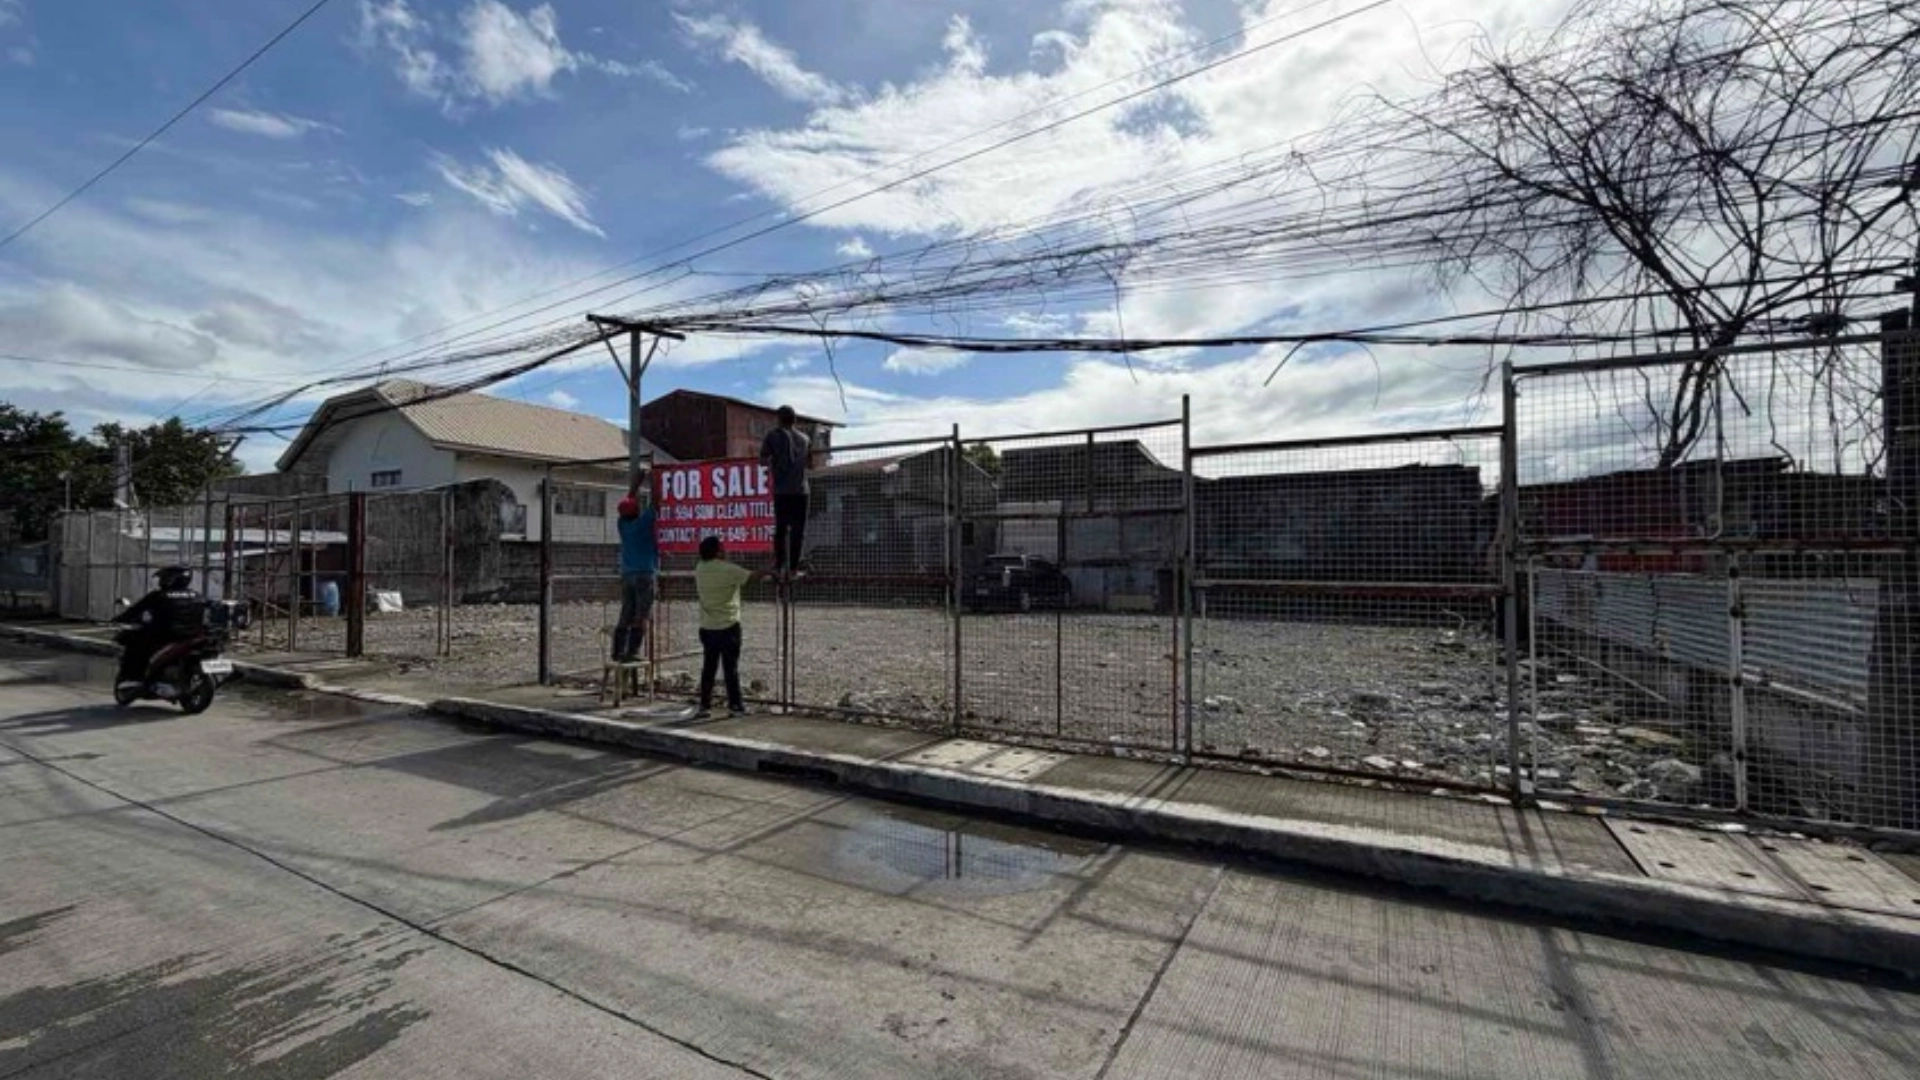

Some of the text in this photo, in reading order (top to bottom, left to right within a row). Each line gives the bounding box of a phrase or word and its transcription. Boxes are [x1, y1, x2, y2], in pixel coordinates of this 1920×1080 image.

[662, 466, 769, 500] FOR SALE
[694, 502, 715, 519] SQM
[717, 502, 747, 519] CLEAN
[749, 501, 775, 518] TITLE
